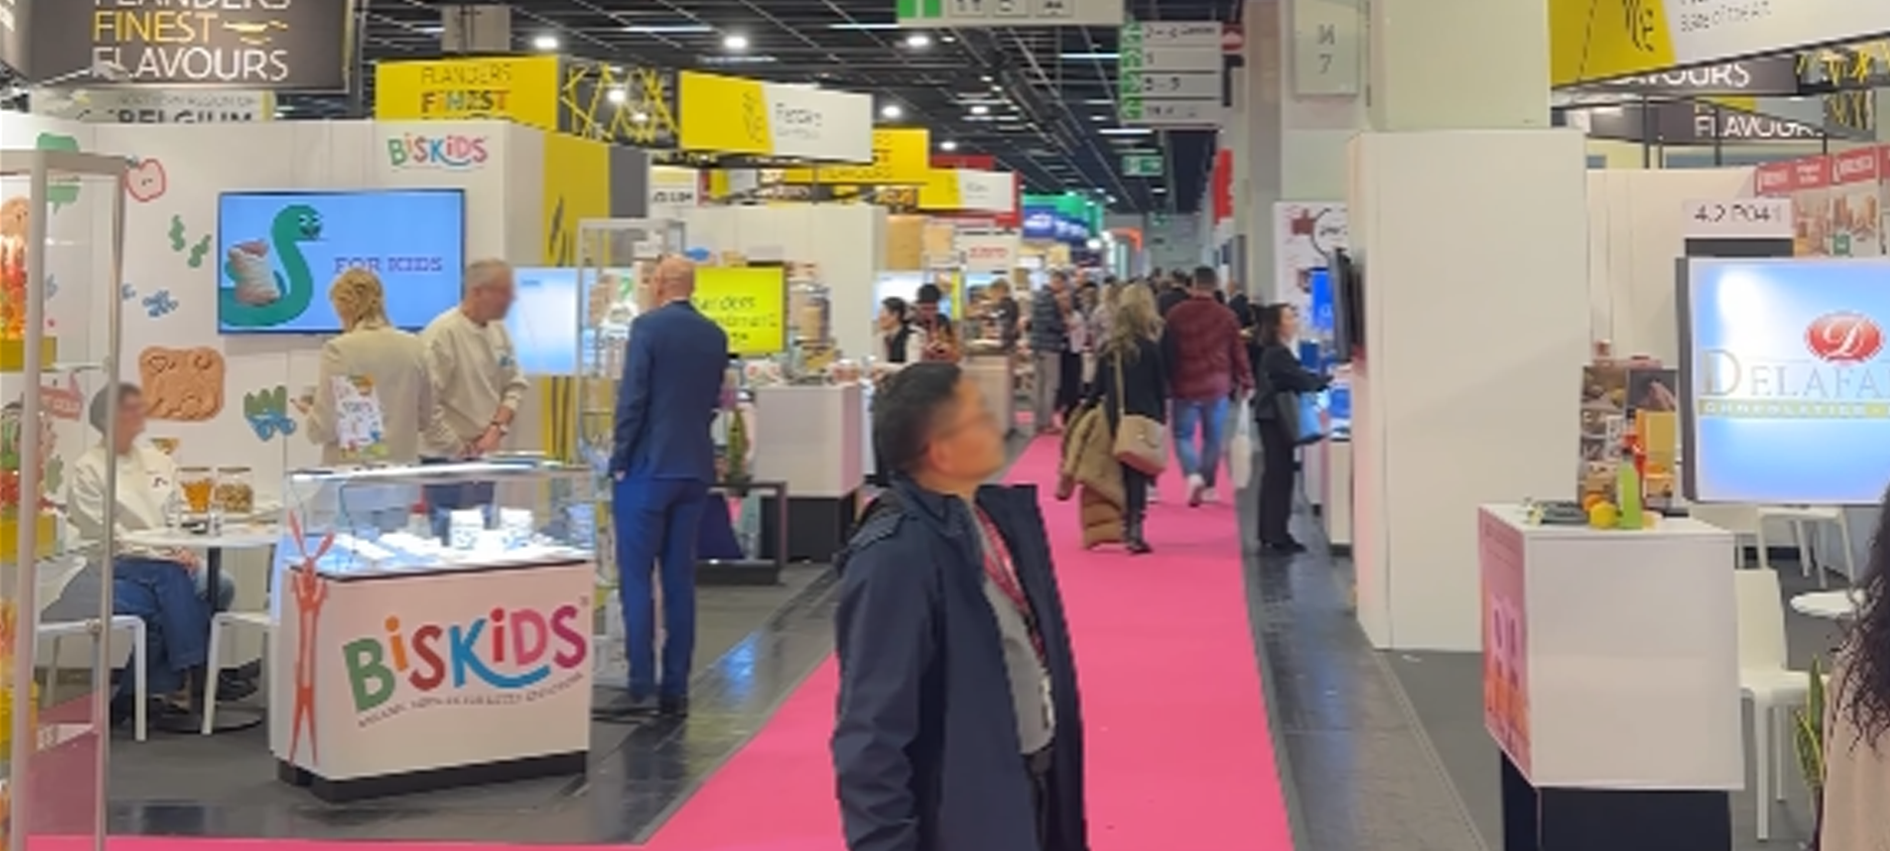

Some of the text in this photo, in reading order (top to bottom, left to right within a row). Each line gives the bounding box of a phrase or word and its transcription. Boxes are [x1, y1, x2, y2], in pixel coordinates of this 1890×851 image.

[93, 11, 219, 42] FINEST
[333, 256, 443, 274] FOR KIDS
[1700, 349, 1890, 400] DELAFA
